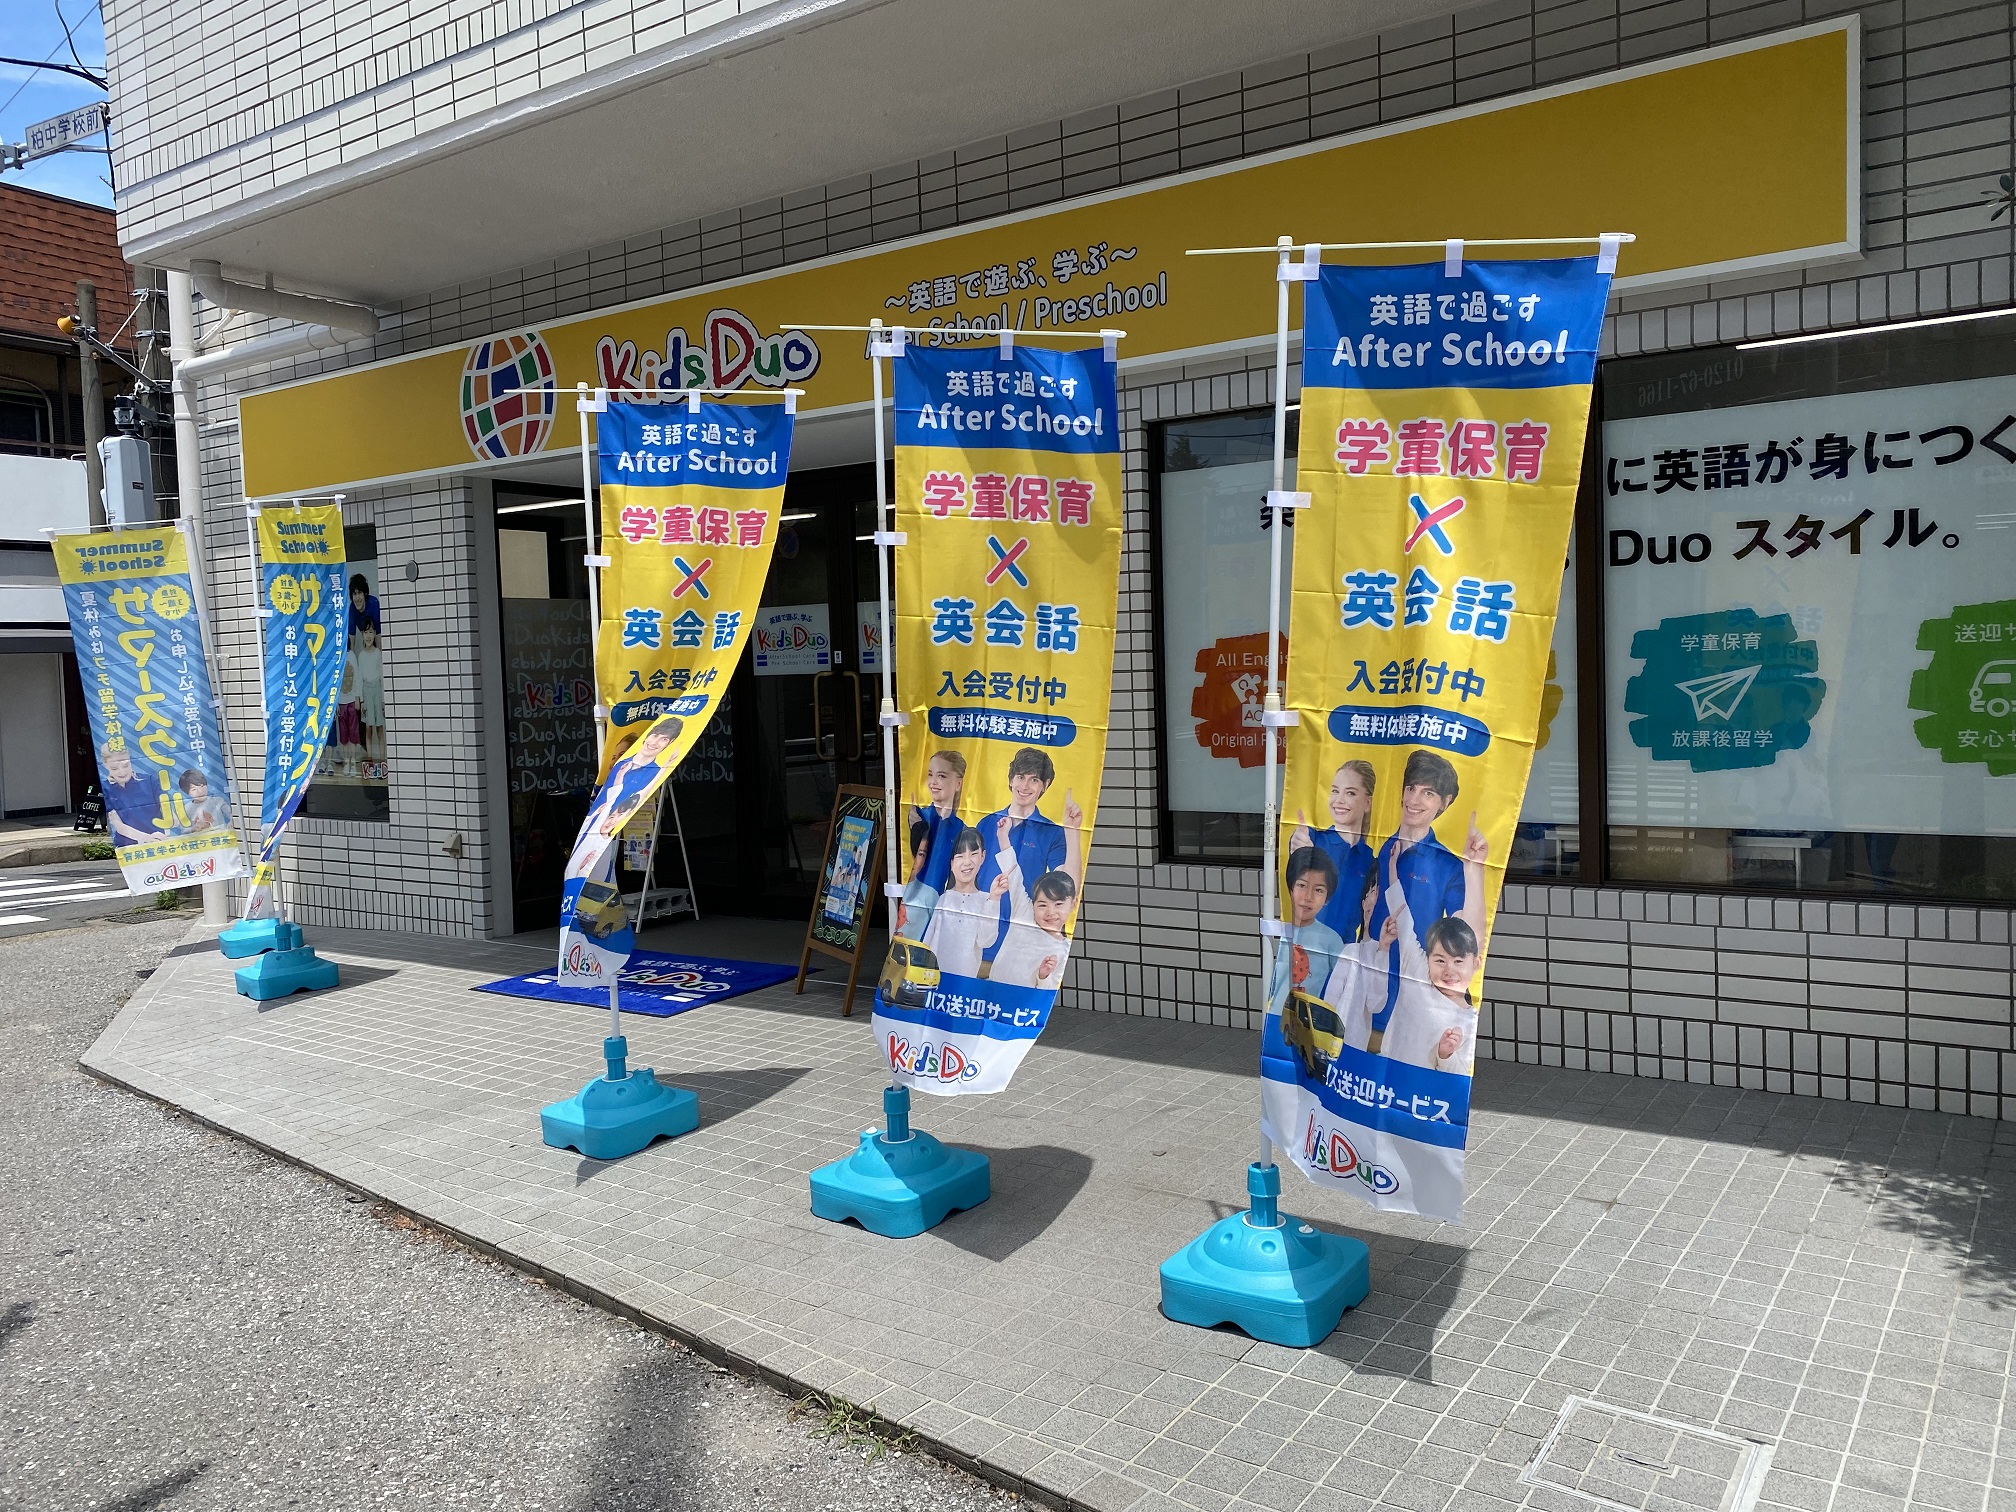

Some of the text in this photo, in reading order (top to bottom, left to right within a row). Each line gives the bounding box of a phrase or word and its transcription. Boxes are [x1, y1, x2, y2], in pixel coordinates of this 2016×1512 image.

[31, 107, 99, 150] 柏中学校前
[928, 302, 1009, 348] School
[1034, 271, 1168, 329] Preschool
[1369, 291, 1541, 326] 英語で過ごす
[599, 311, 818, 403] KidsDuo
[1332, 329, 1569, 368] After School
[947, 370, 1078, 400] 英語で過ごす
[641, 422, 757, 447] 英語で過ごす
[917, 403, 1104, 436] After School
[617, 448, 777, 475] After School
[1336, 417, 1549, 482] 学童保育
[1606, 414, 2016, 496] に英語が身につく
[923, 471, 1095, 527] 学童保育
[277, 521, 326, 535] Summer
[620, 505, 768, 548] 学童保育
[1609, 508, 1960, 568] Duo スタイル。
[1340, 565, 1516, 644] 英会話
[622, 607, 743, 651] 英会話
[757, 625, 829, 652] KidsDuo
[931, 596, 1081, 654] 英会話
[1680, 632, 1762, 652] 学童保育
[1216, 653, 1237, 666] All
[525, 680, 592, 709] KidsD
[624, 667, 718, 692] 入会受付中
[937, 669, 1067, 706] 入会受付中
[1346, 658, 1486, 702] 入会受付中
[940, 714, 1058, 740] 無料体験実施中
[1211, 732, 1257, 748] Original
[1672, 729, 1773, 748] 放課後留学
[887, 1032, 981, 1082] KidsDo
